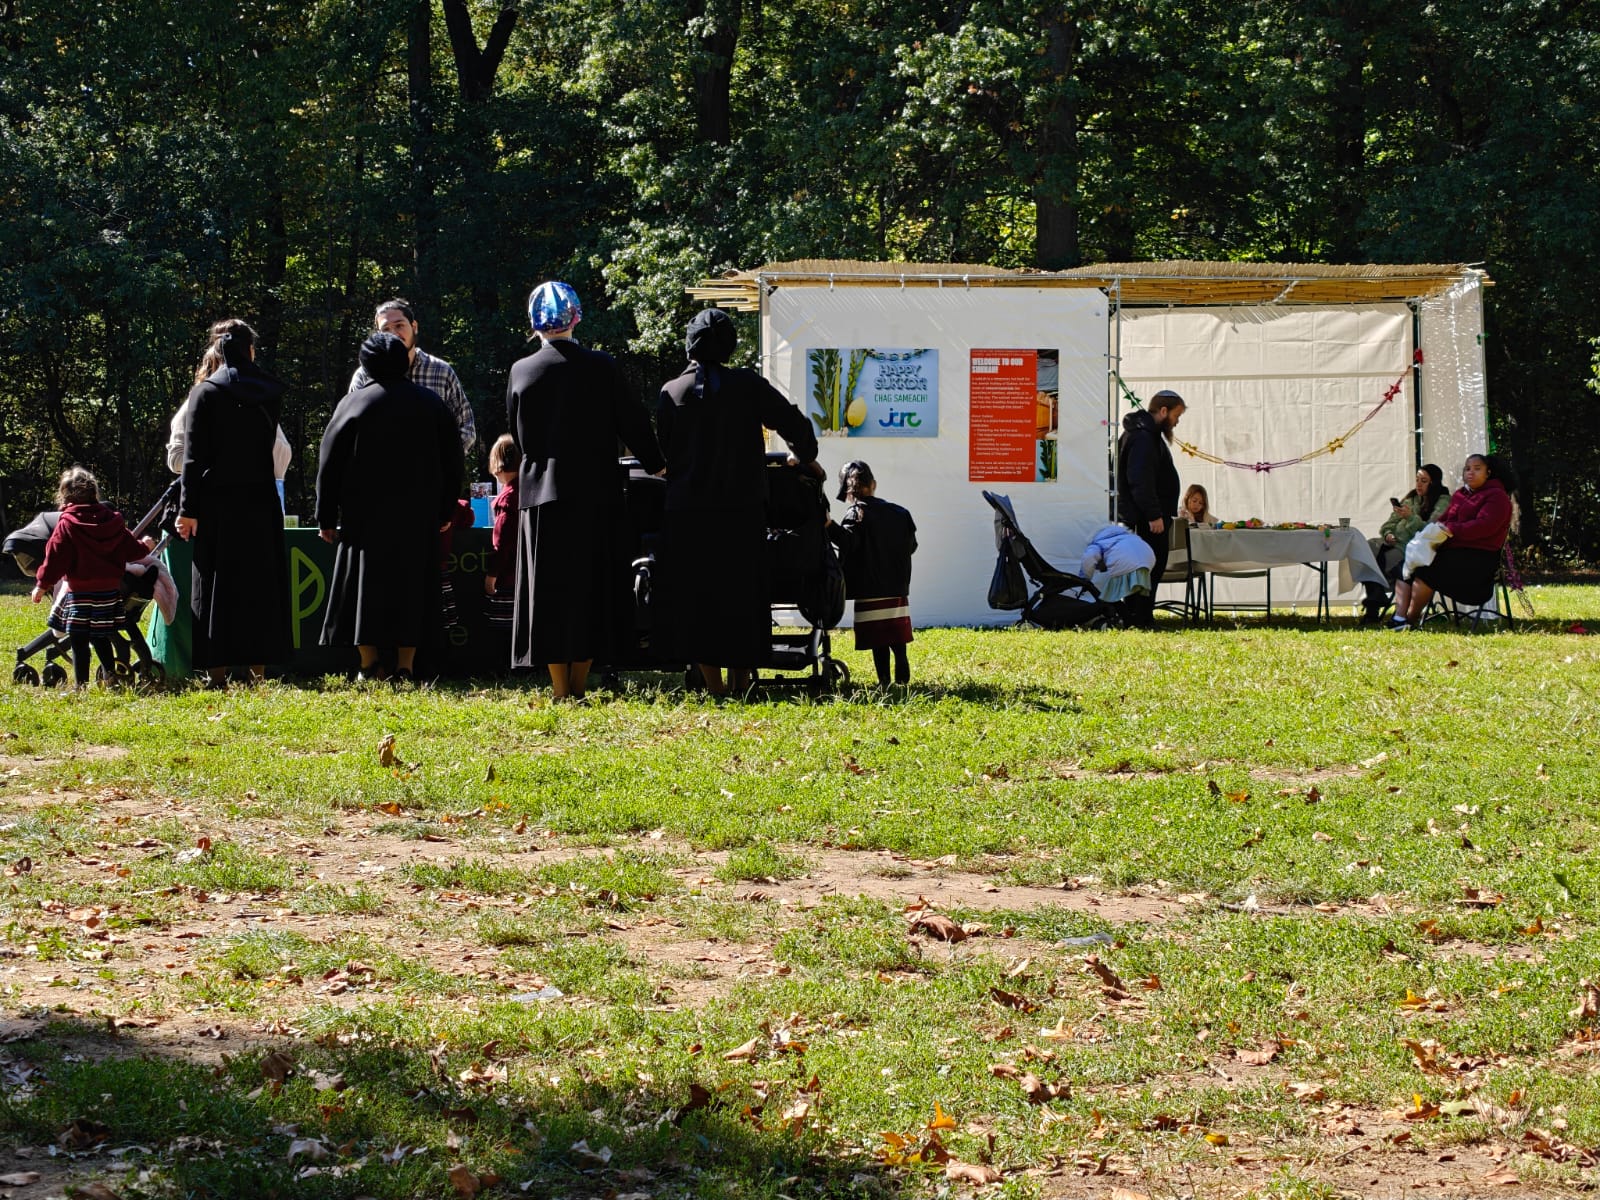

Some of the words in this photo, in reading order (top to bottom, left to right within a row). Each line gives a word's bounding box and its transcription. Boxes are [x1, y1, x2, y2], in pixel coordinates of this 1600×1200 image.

[879, 364, 922, 377] HAPPY
[874, 393, 892, 403] CHAG
[894, 393, 928, 403] SAMEACH!
